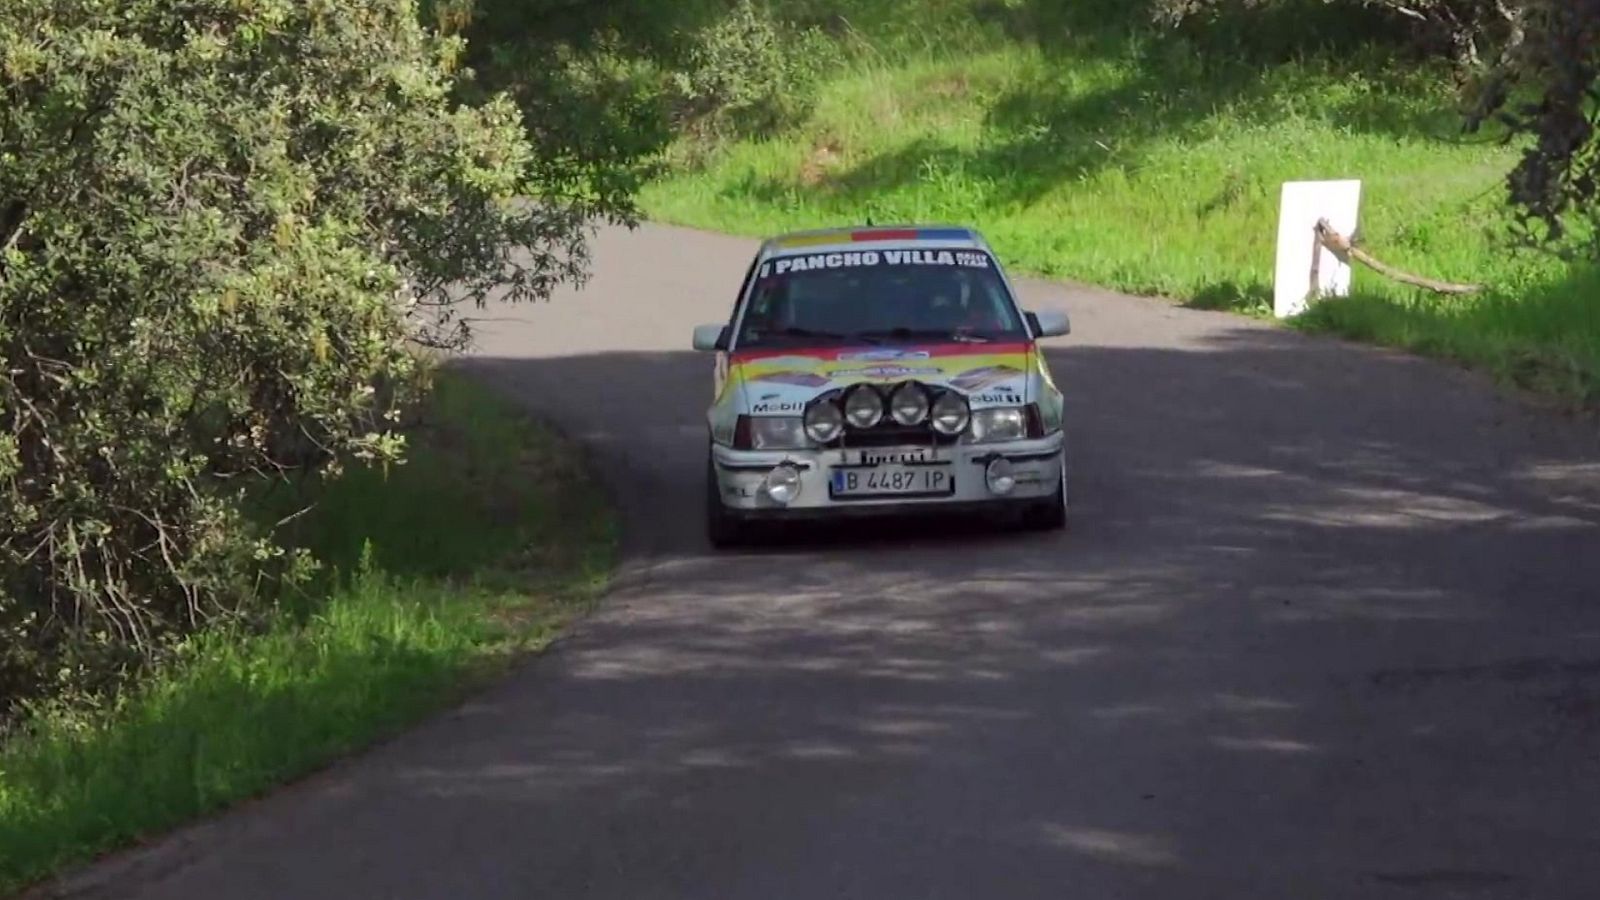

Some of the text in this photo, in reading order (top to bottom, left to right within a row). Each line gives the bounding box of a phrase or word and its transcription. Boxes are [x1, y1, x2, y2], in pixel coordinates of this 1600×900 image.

[775, 251, 880, 274] PANCHO
[883, 250, 955, 265] VILLA
[847, 471, 944, 490] B 4487 IP
